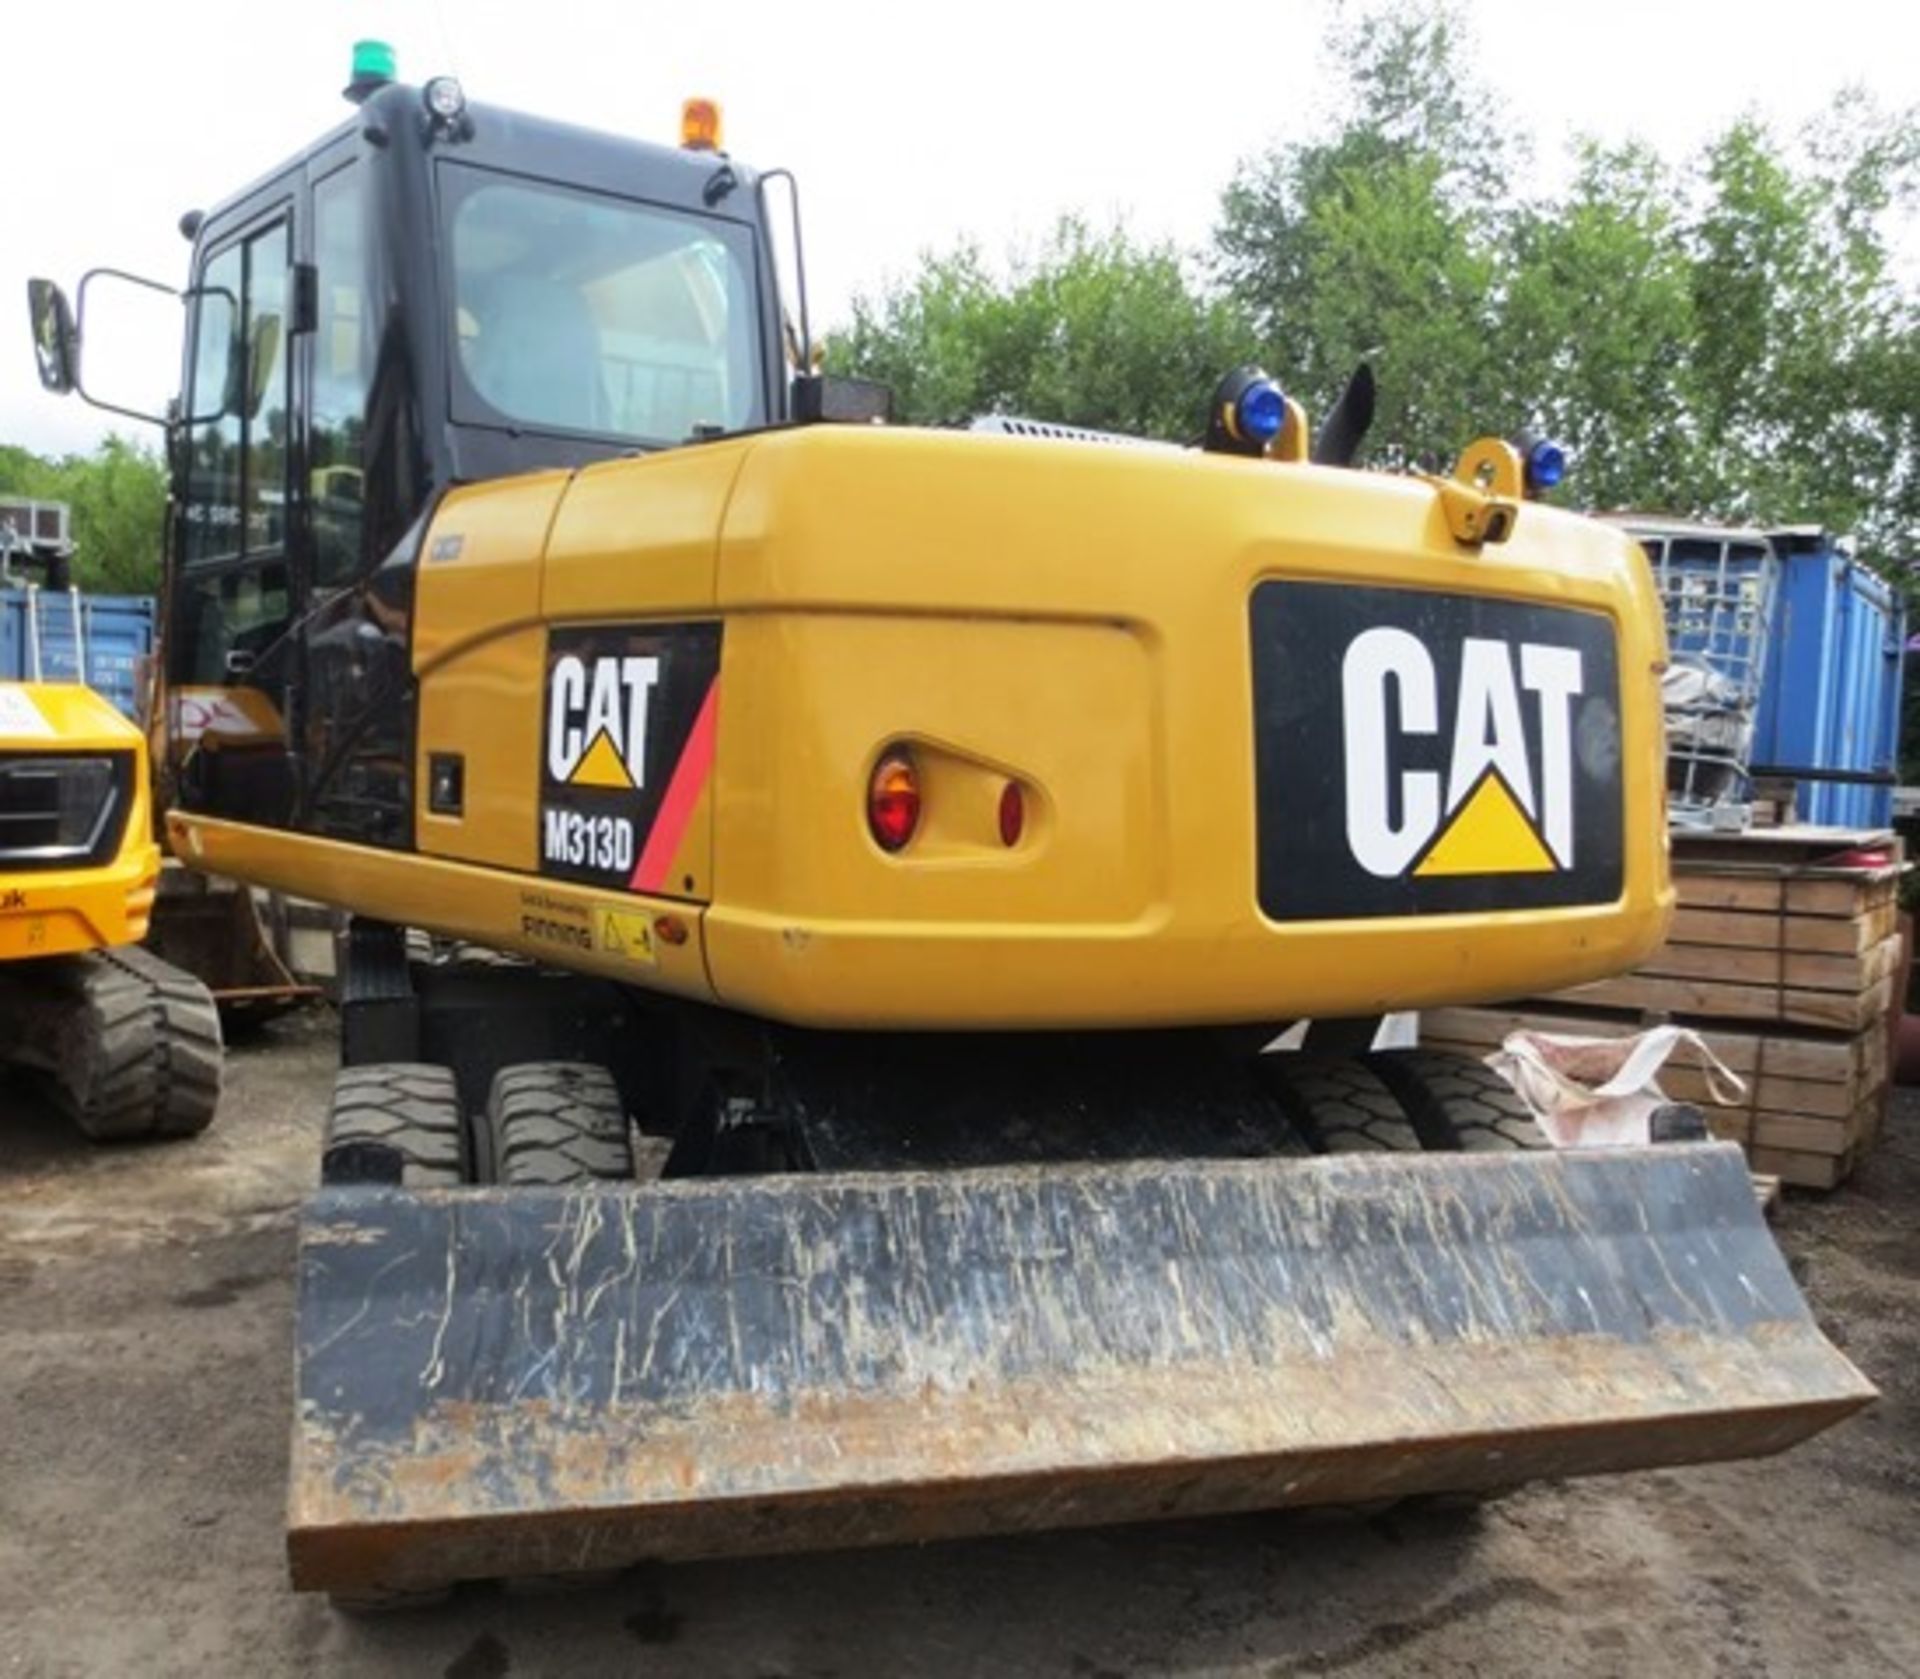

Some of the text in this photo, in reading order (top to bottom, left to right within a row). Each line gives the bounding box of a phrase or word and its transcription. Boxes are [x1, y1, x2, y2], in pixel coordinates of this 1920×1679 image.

[549, 655, 659, 789] CAT
[1342, 627, 1583, 878] CAT
[544, 808, 633, 873] M313D
